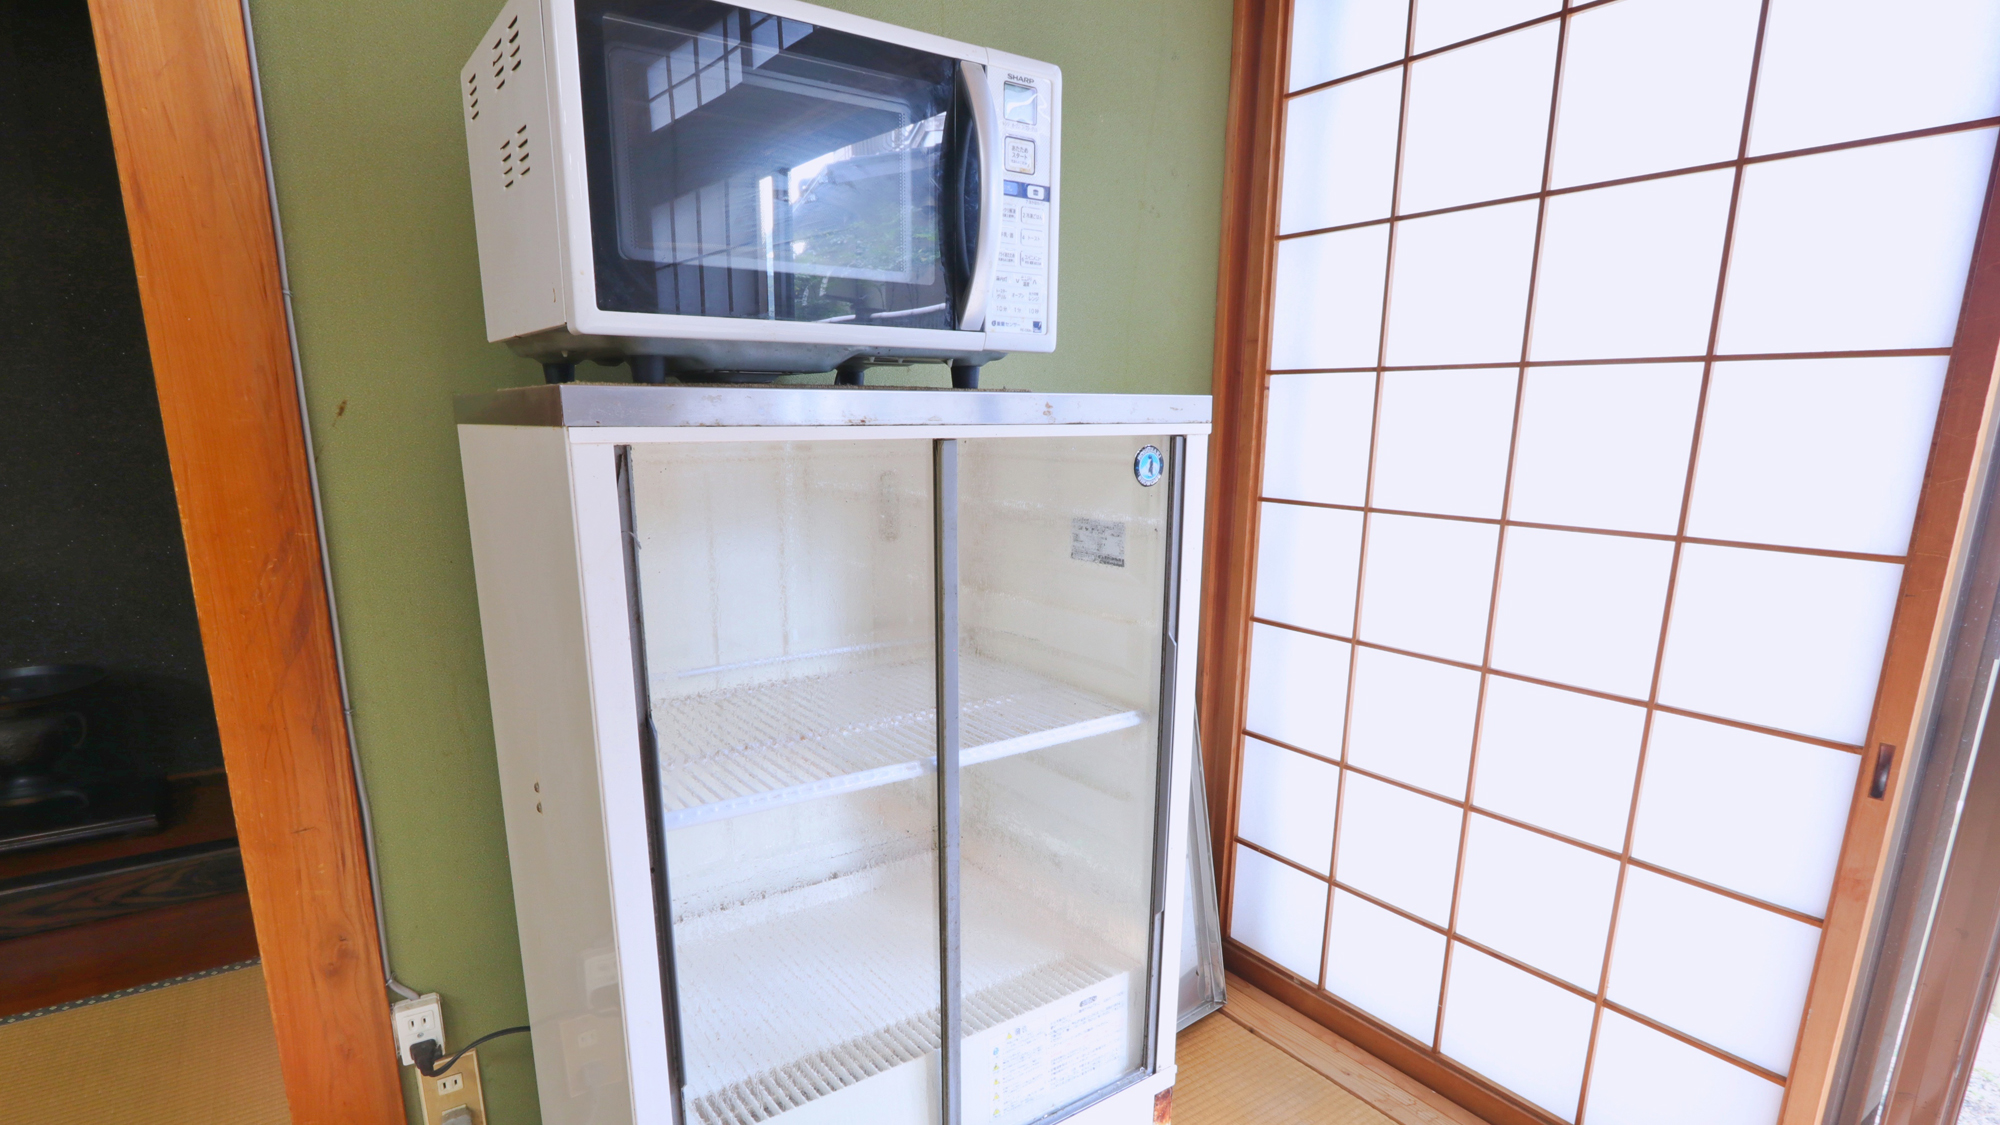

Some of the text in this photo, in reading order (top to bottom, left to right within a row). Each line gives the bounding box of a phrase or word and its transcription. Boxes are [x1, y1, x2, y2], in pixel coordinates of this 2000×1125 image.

[1007, 73, 1035, 84] SHARP
[1011, 145, 1029, 154] あたため
[1011, 152, 1028, 160] スタート
